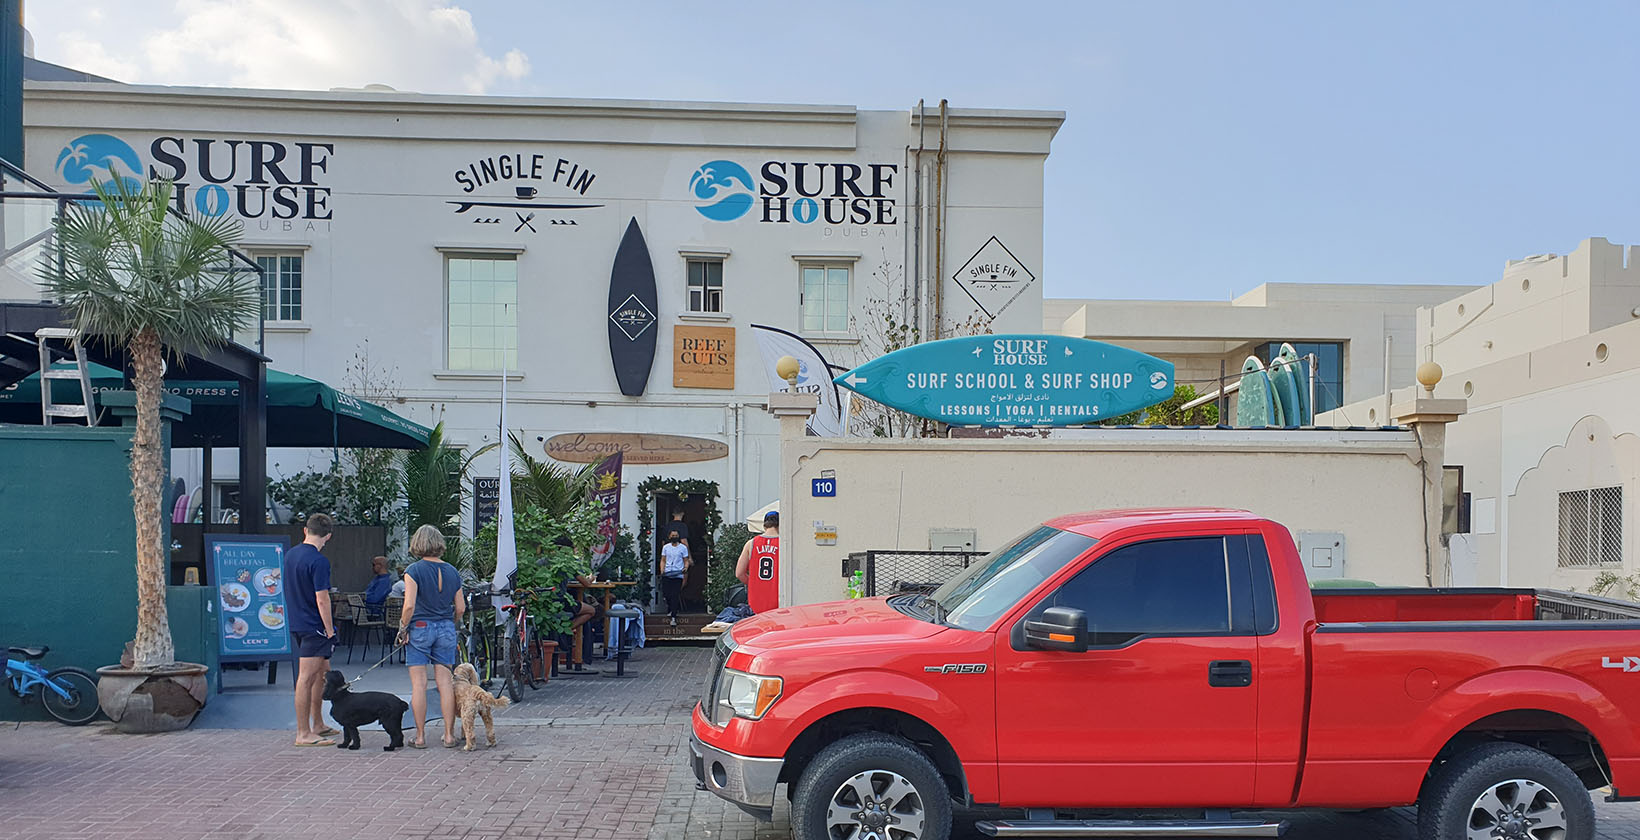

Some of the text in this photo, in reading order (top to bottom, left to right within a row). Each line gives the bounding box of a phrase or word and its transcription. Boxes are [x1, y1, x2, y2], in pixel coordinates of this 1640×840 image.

[150, 137, 334, 185] SURF
[455, 154, 596, 196] SINGLE FIN
[760, 161, 898, 198] SURF
[150, 182, 333, 219] HOUSE
[760, 196, 898, 225] HOUSE
[234, 219, 331, 232] DUBAI
[824, 227, 898, 238] DUBAI
[970, 264, 1018, 278] SINGLE FIN
[637, 310, 646, 318] FIN
[682, 338, 726, 351] REEF
[993, 339, 1048, 354] SURF
[681, 352, 728, 366] CUTS
[993, 354, 1048, 366] HOUSE
[907, 373, 1133, 389] SURF SCHOOL & SURF SHOP
[186, 388, 226, 396] DRESS
[941, 405, 990, 415] LESSONS
[1006, 405, 1034, 415] YOGA
[1050, 405, 1099, 415] RENTALS
[549, 433, 632, 453] welcome
[815, 482, 832, 493] 110
[759, 556, 774, 580] 8
[942, 663, 987, 674] F-150
